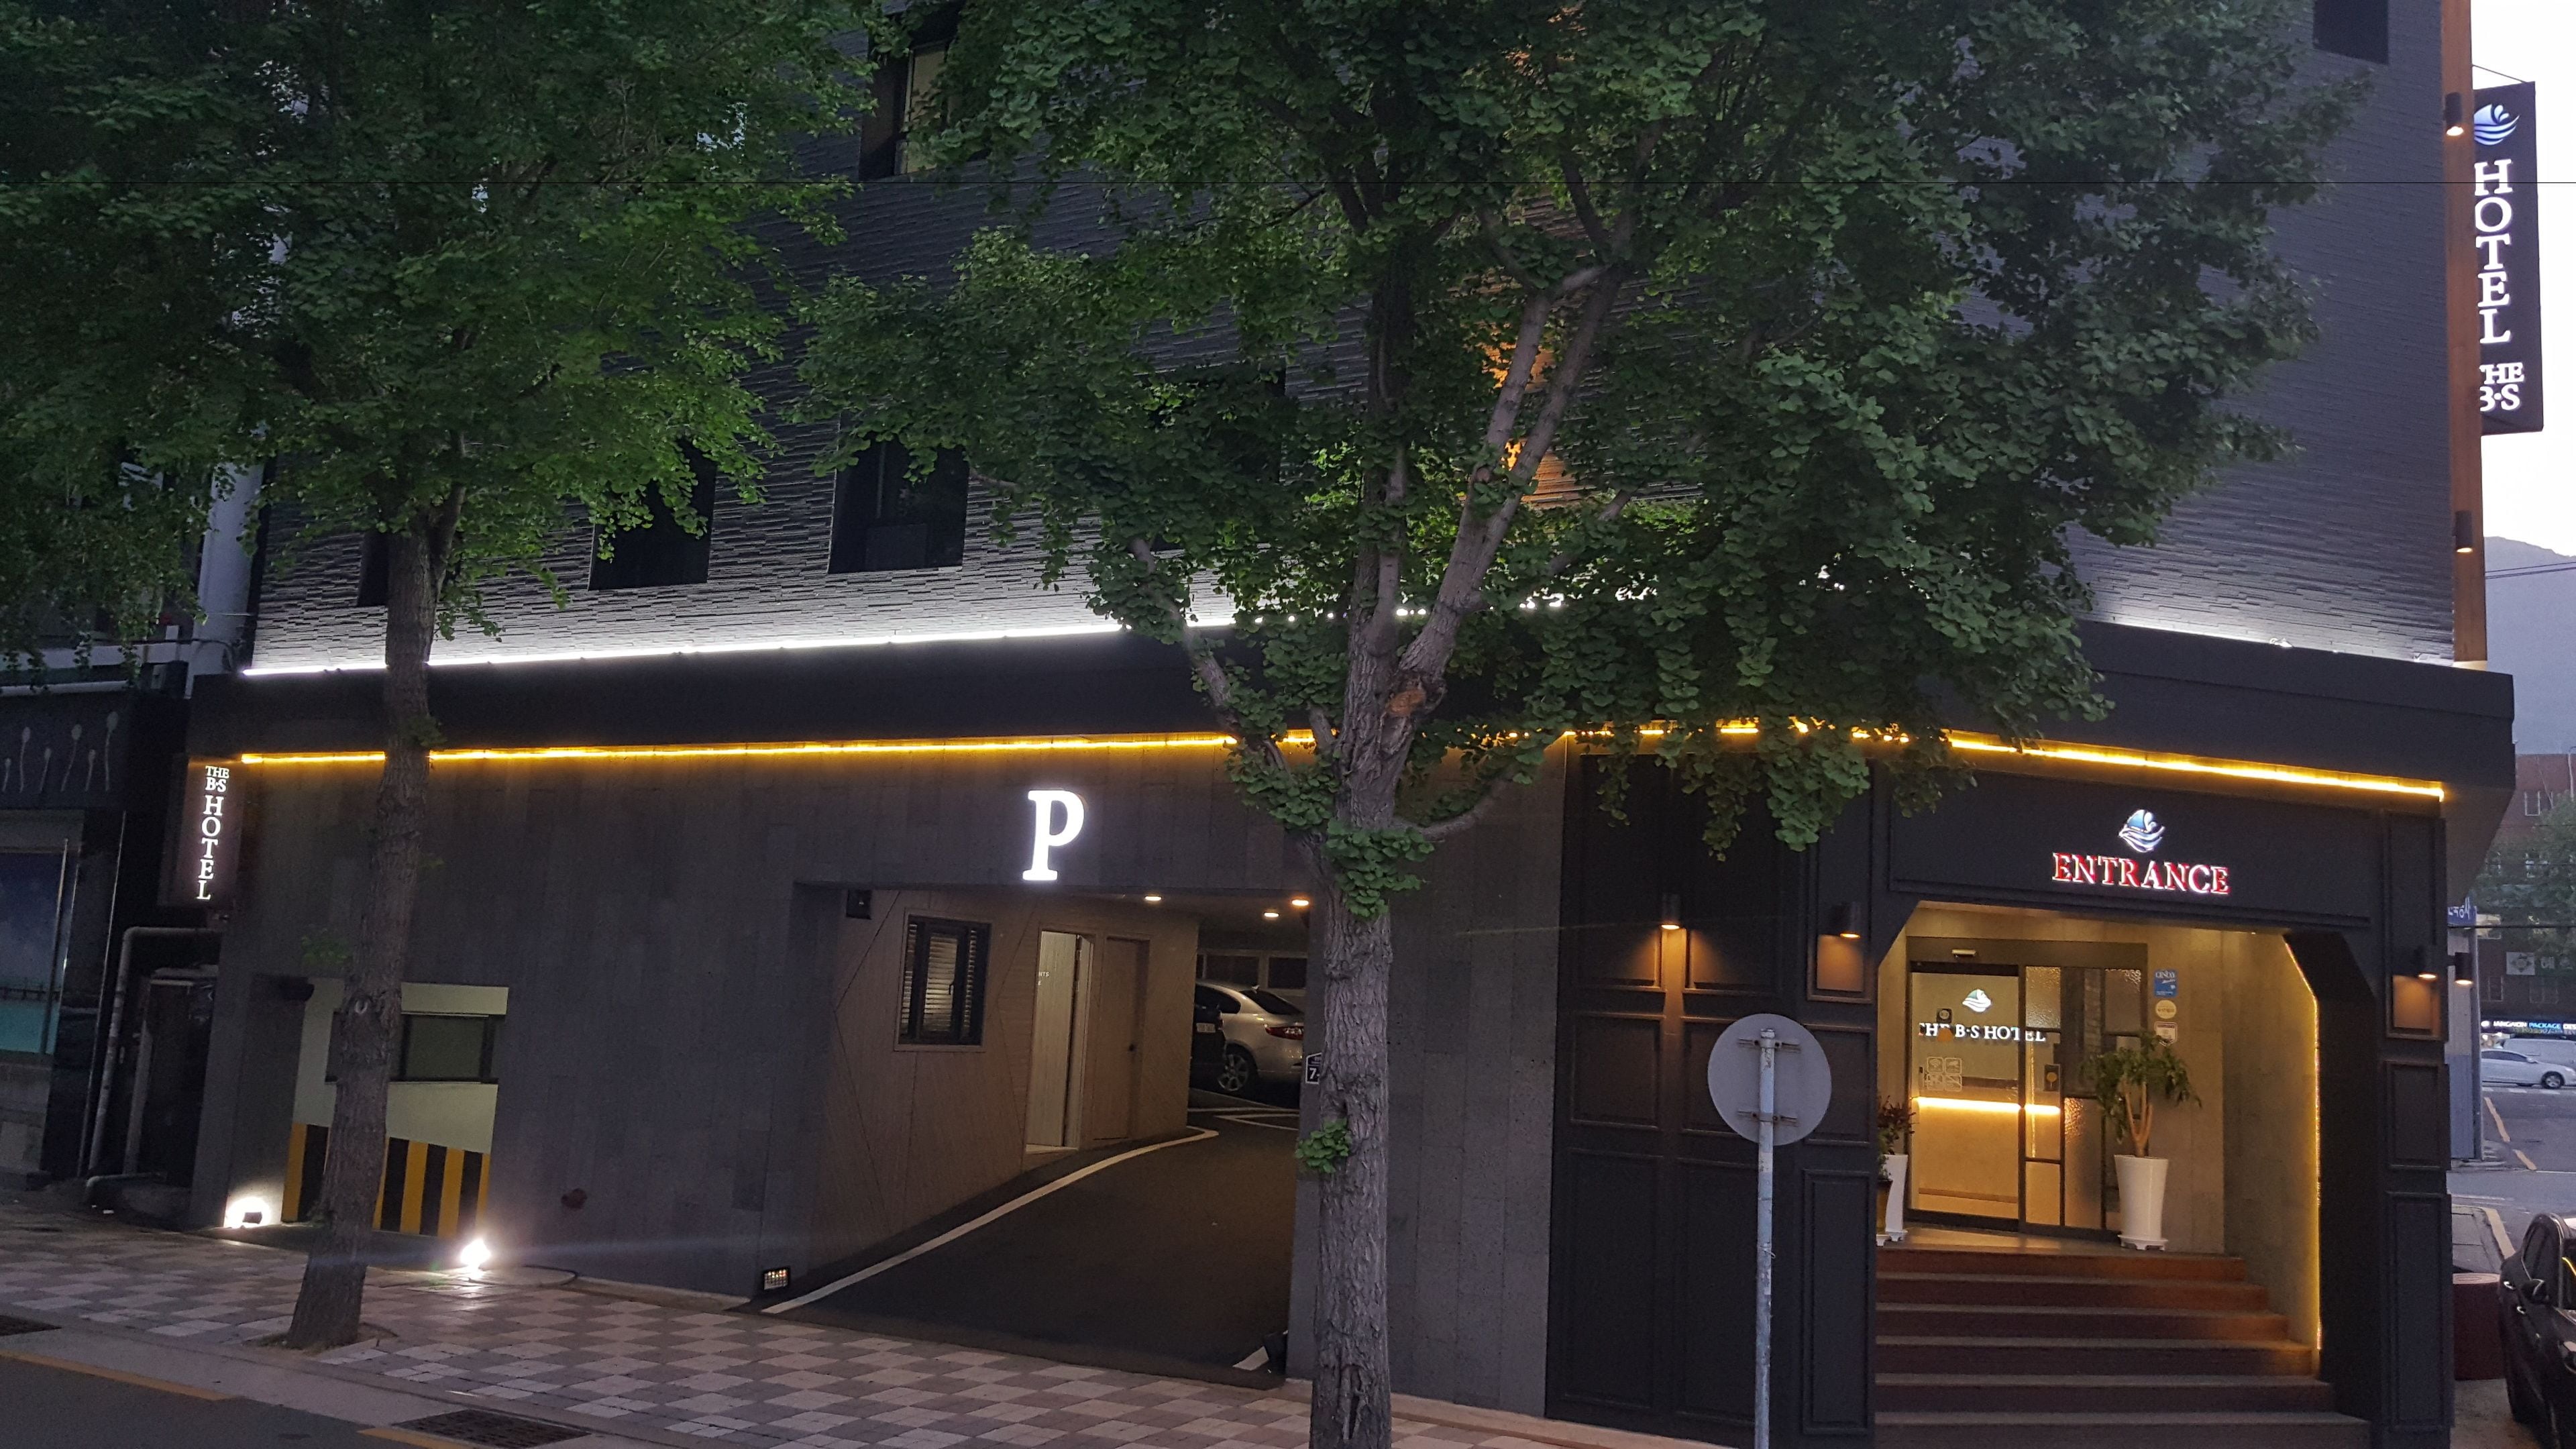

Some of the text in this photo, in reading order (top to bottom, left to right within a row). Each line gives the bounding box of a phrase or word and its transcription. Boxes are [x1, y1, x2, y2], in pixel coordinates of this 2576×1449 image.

[2474, 158, 2513, 344] HOTEL
[205, 765, 229, 779] THE
[197, 795, 224, 900] HOTEL
[1022, 790, 1085, 881] P
[2051, 852, 2231, 895] ENTRANCE
[1984, 1025, 2046, 1042] HOTEL
